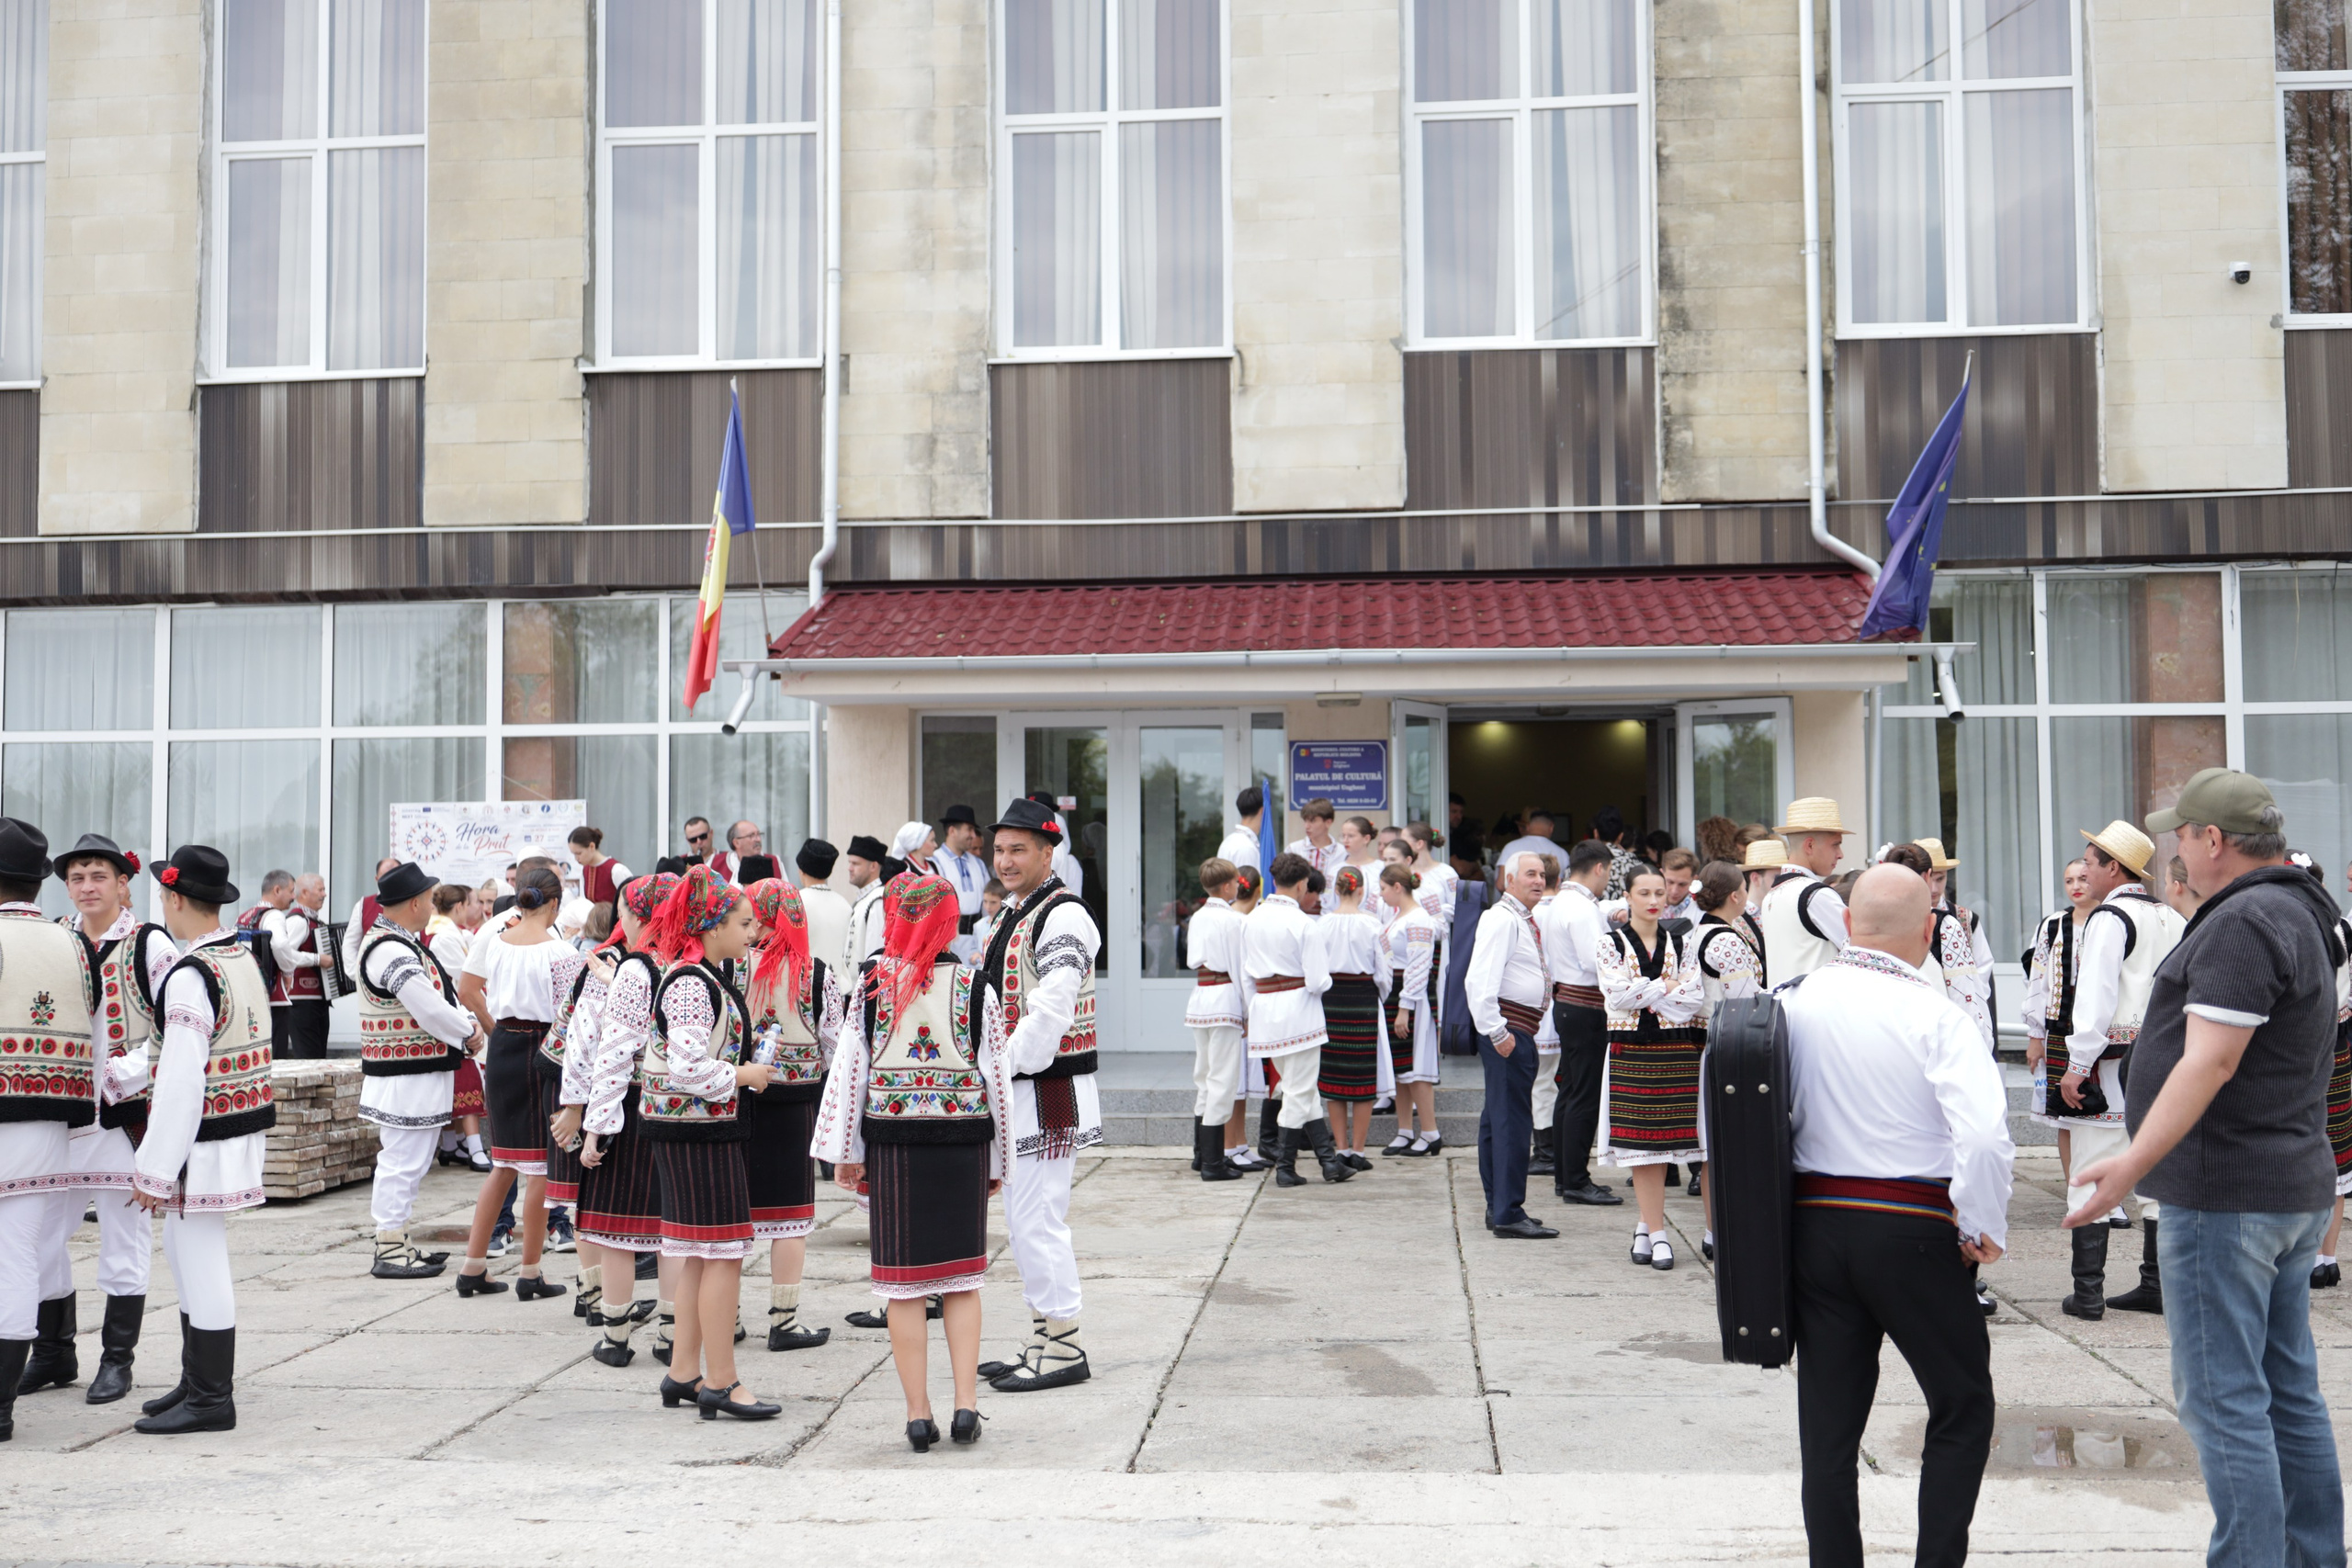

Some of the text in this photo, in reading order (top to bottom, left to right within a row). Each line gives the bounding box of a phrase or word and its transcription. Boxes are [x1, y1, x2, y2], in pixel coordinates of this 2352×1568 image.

[1345, 772, 1382, 780] CULTURĂ
[457, 822, 500, 841] Hora
[474, 833, 512, 856] Prut
